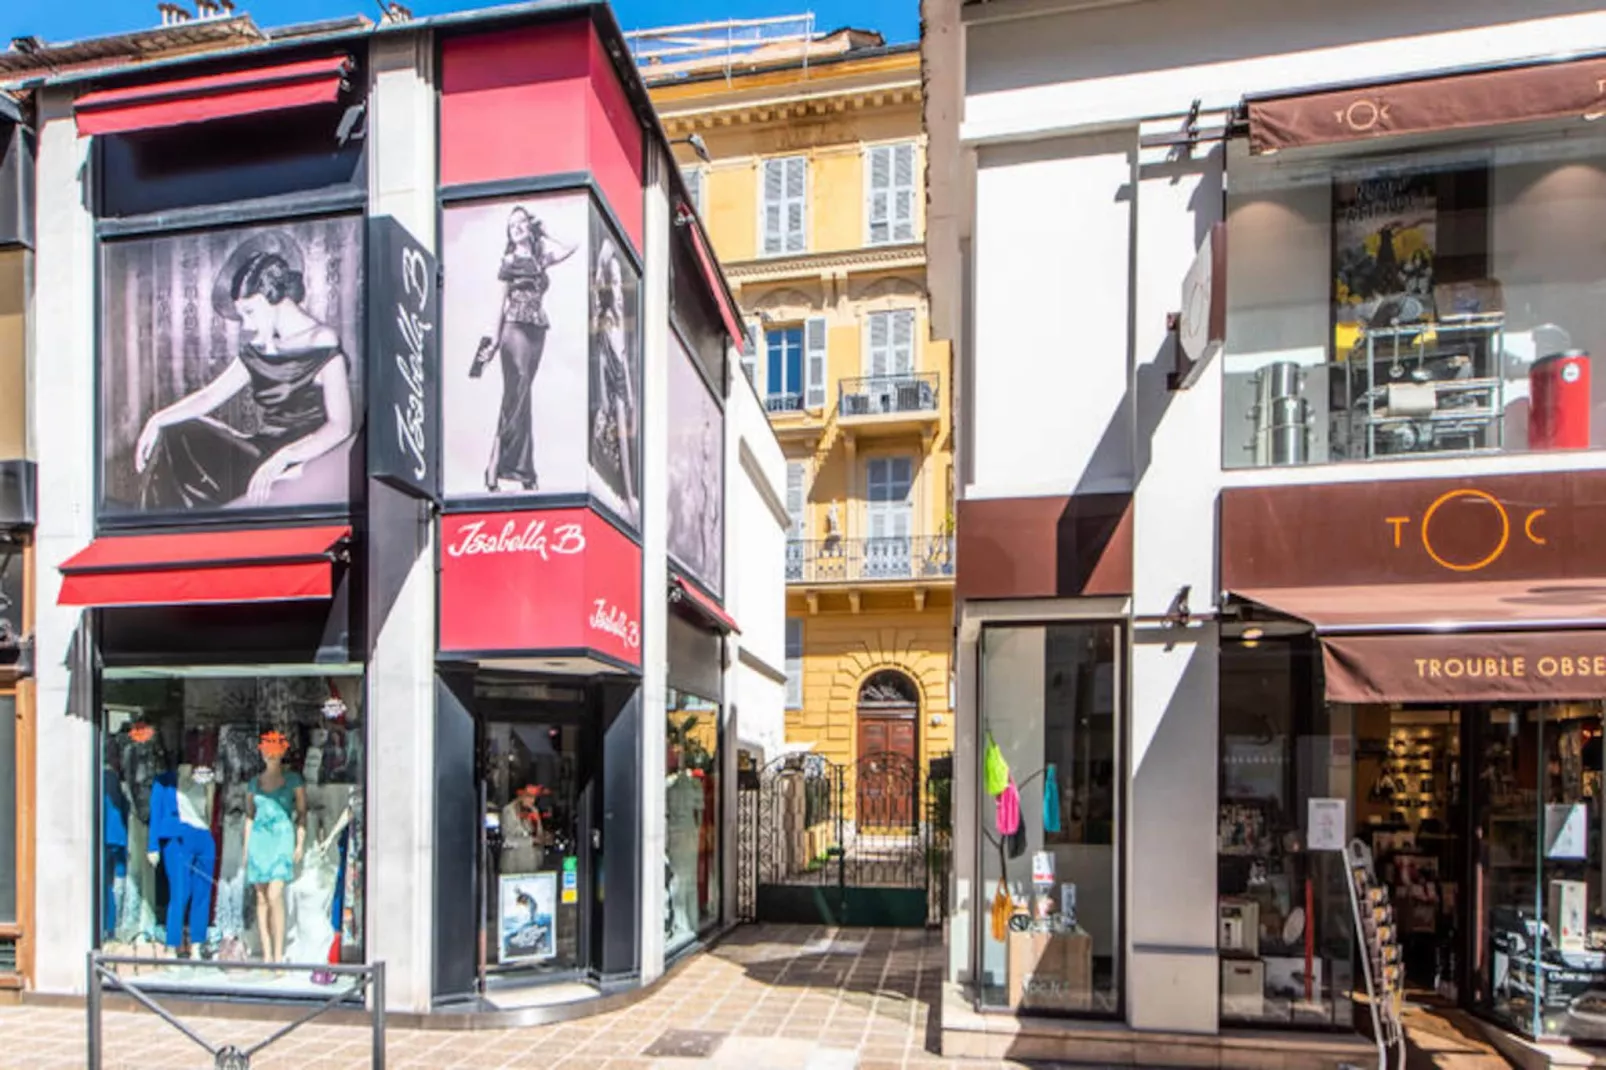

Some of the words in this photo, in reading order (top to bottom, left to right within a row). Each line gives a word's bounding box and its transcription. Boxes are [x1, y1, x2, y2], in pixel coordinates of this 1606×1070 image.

[402, 246, 428, 312] B
[395, 302, 432, 481] Isabella
[448, 520, 548, 561] Isabella
[551, 524, 586, 554] B
[1385, 488, 1546, 572] TOC
[589, 598, 627, 647] Isabella
[1415, 657, 1526, 677] TROUBLE
[1537, 655, 1606, 676] OBSE
